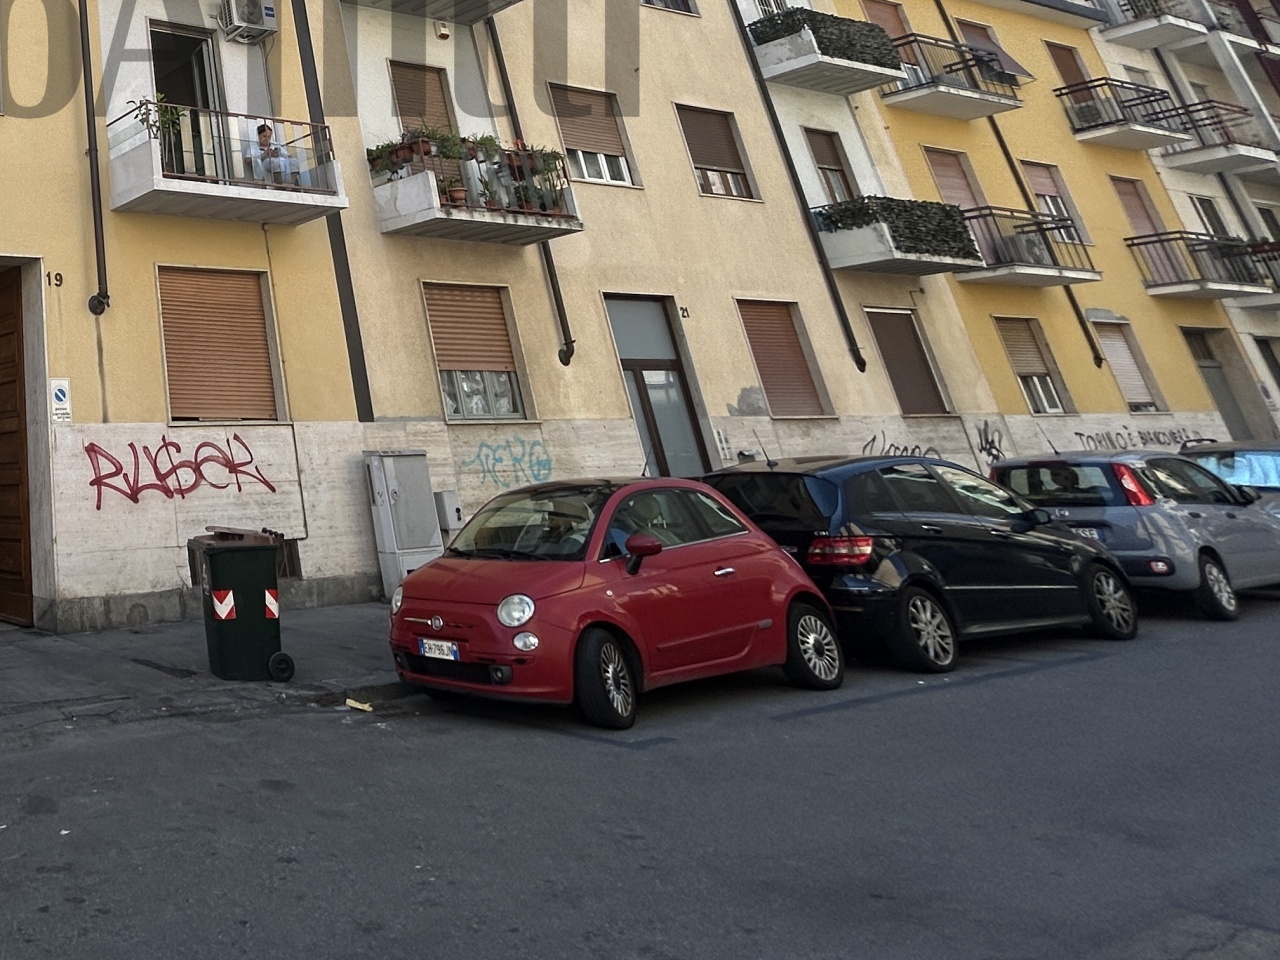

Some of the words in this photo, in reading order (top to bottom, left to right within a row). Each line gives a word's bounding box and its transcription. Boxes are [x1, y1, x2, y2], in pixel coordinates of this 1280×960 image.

[46, 271, 63, 287] 19
[680, 306, 690, 318] 21
[1074, 431, 1128, 451] TORINO
